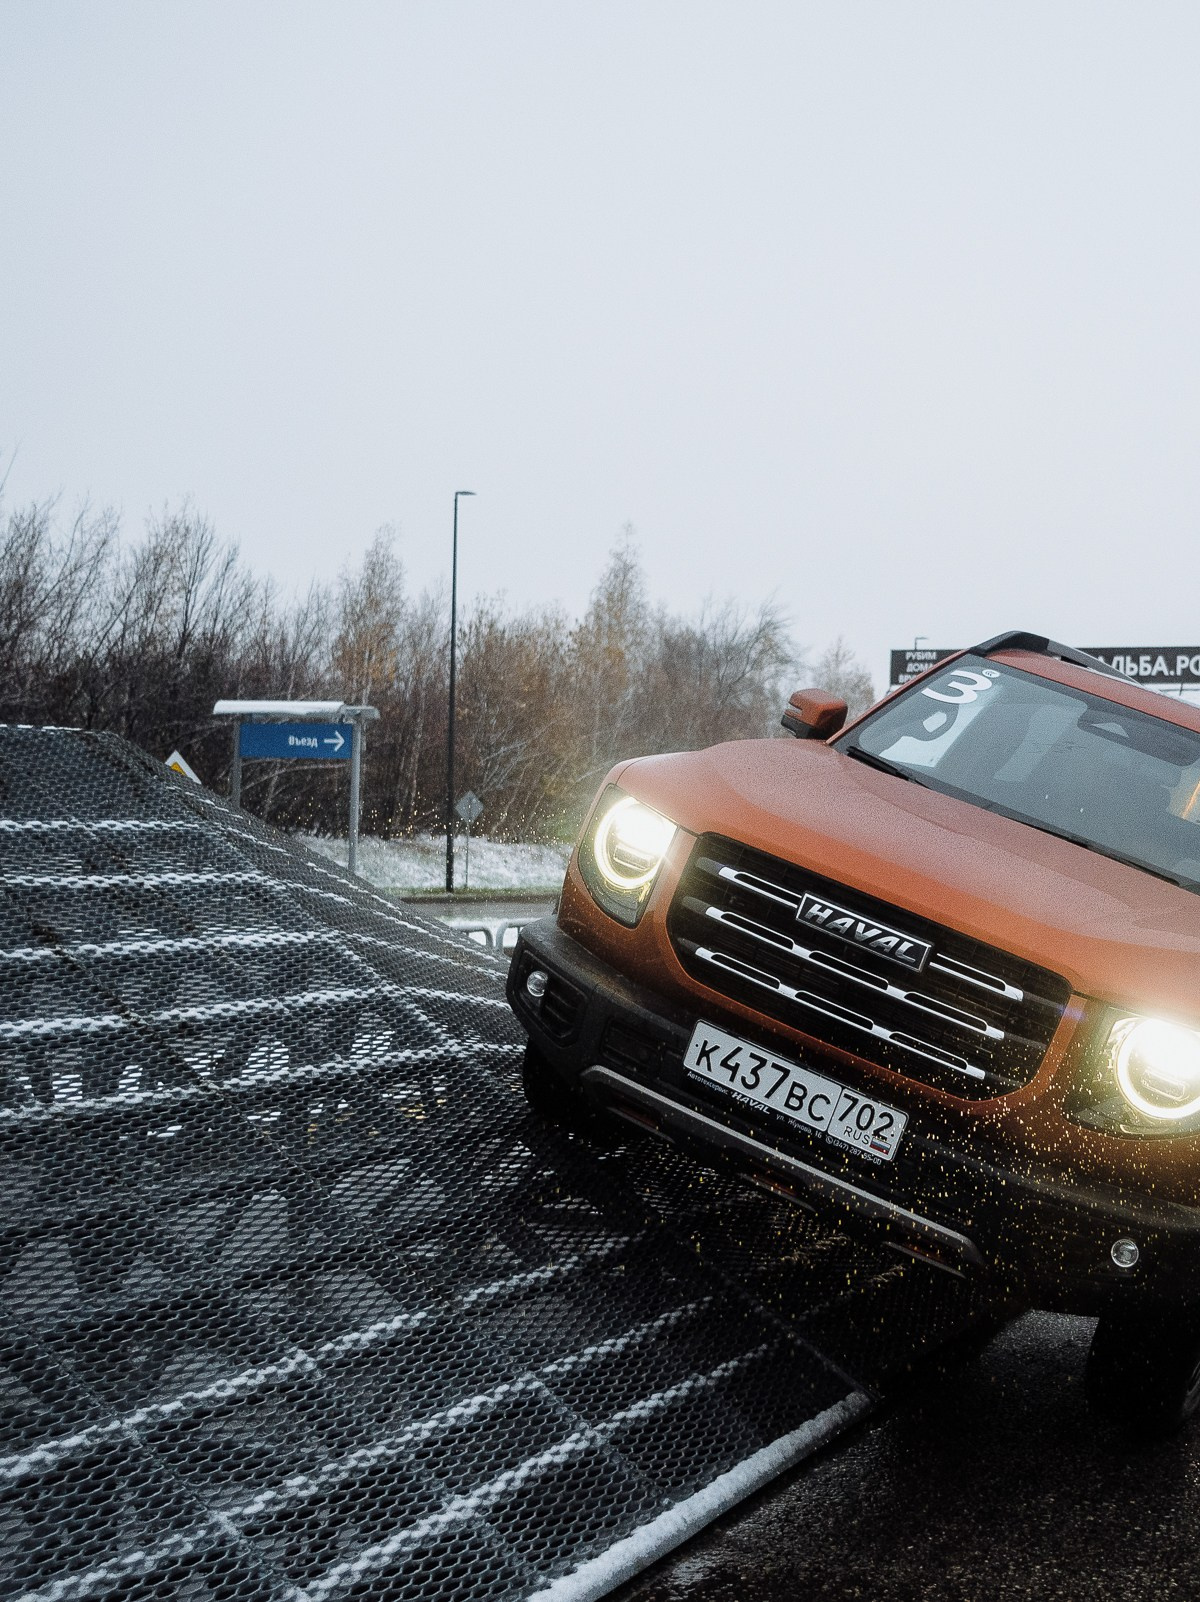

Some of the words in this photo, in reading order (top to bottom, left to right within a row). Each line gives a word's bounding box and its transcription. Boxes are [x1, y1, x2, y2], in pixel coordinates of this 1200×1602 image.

[905, 651, 936, 660] РУБИМ
[805, 903, 916, 963] HAVAL
[731, 1091, 770, 1114] HAVAL
[815, 1130, 822, 1138] 16
[838, 1093, 894, 1140] 702
[843, 1126, 871, 1145] RUS
